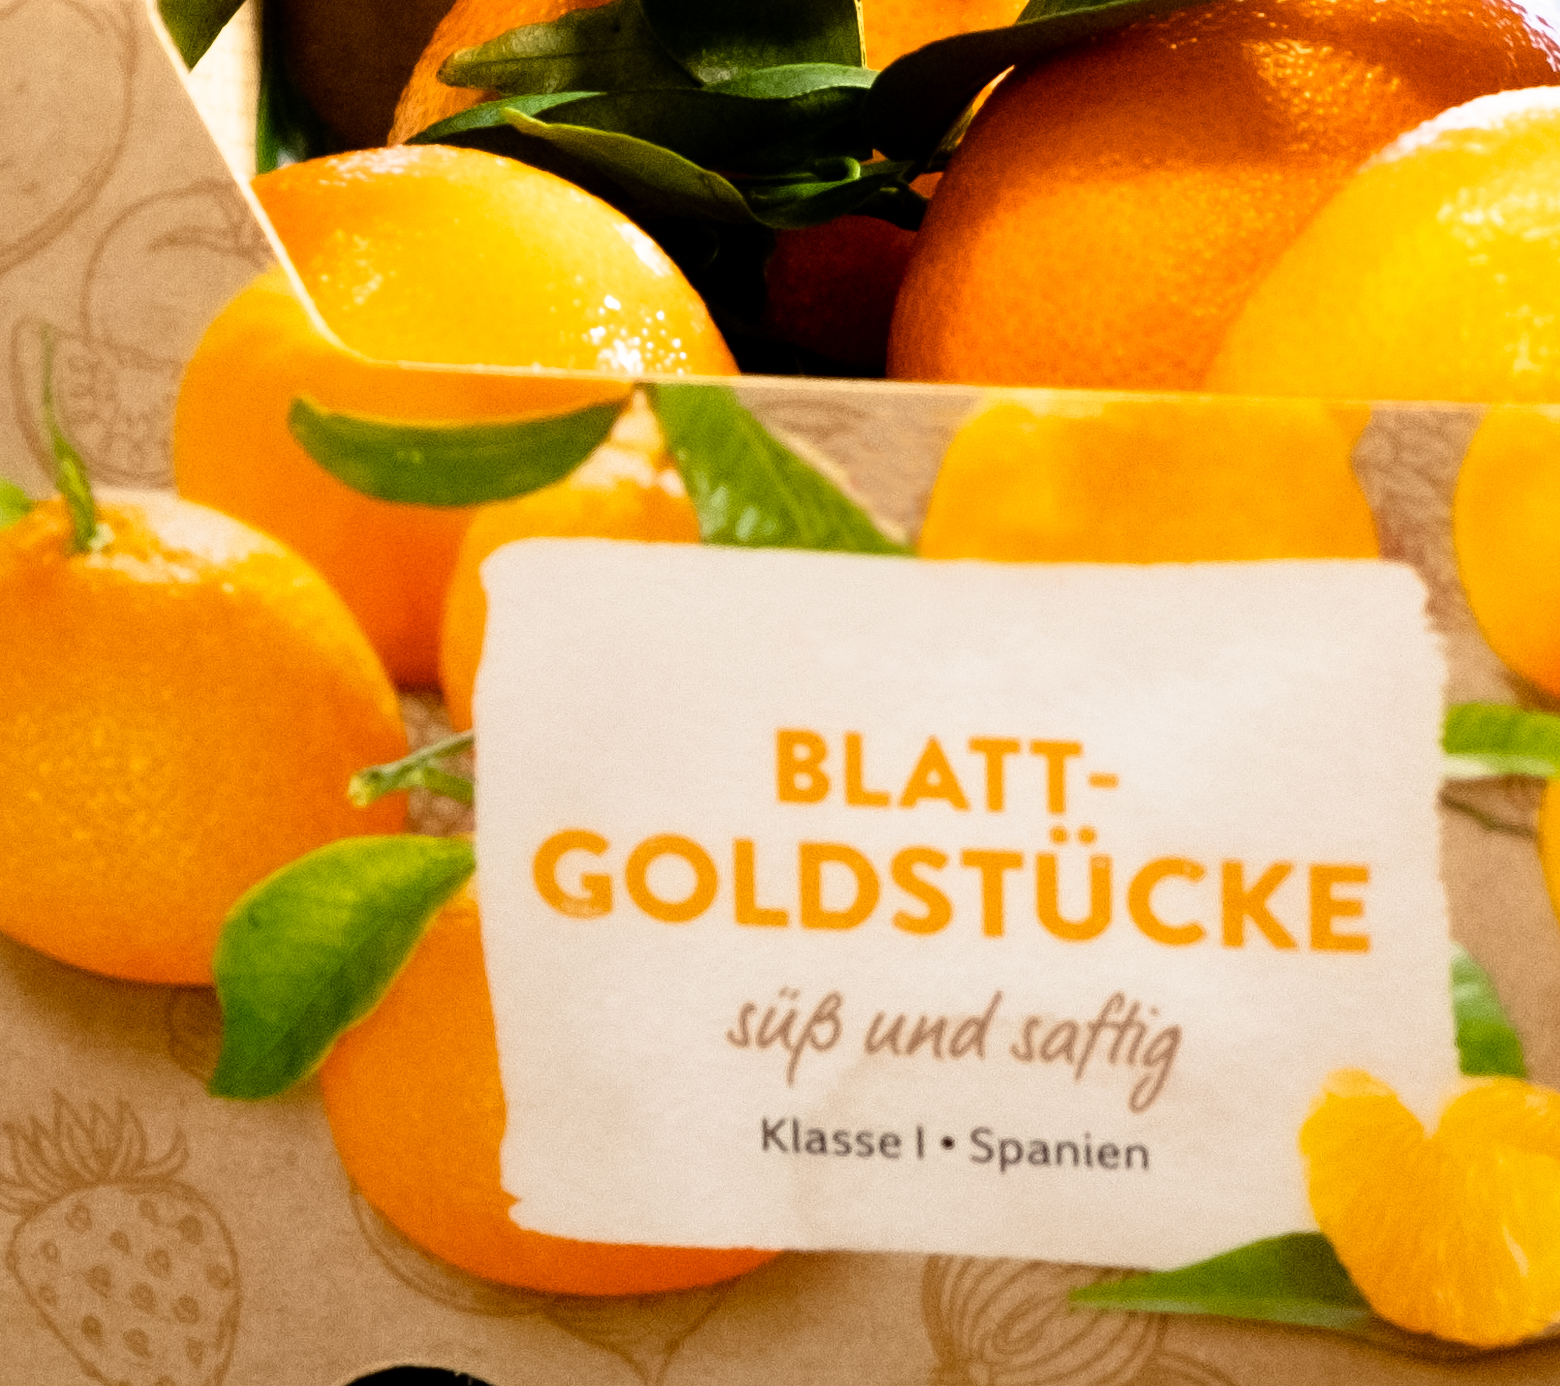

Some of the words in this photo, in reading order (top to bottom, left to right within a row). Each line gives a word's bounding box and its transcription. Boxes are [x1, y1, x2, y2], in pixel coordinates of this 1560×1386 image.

[774, 727, 1121, 816] BLATT-
[530, 824, 1372, 954] GOLDSTÜCKE
[727, 988, 843, 1085] süß
[865, 989, 1004, 1065] und
[1010, 988, 1184, 1113] saftig
[758, 1116, 904, 1160] Klasse
[968, 1126, 1152, 1177] Spanien
